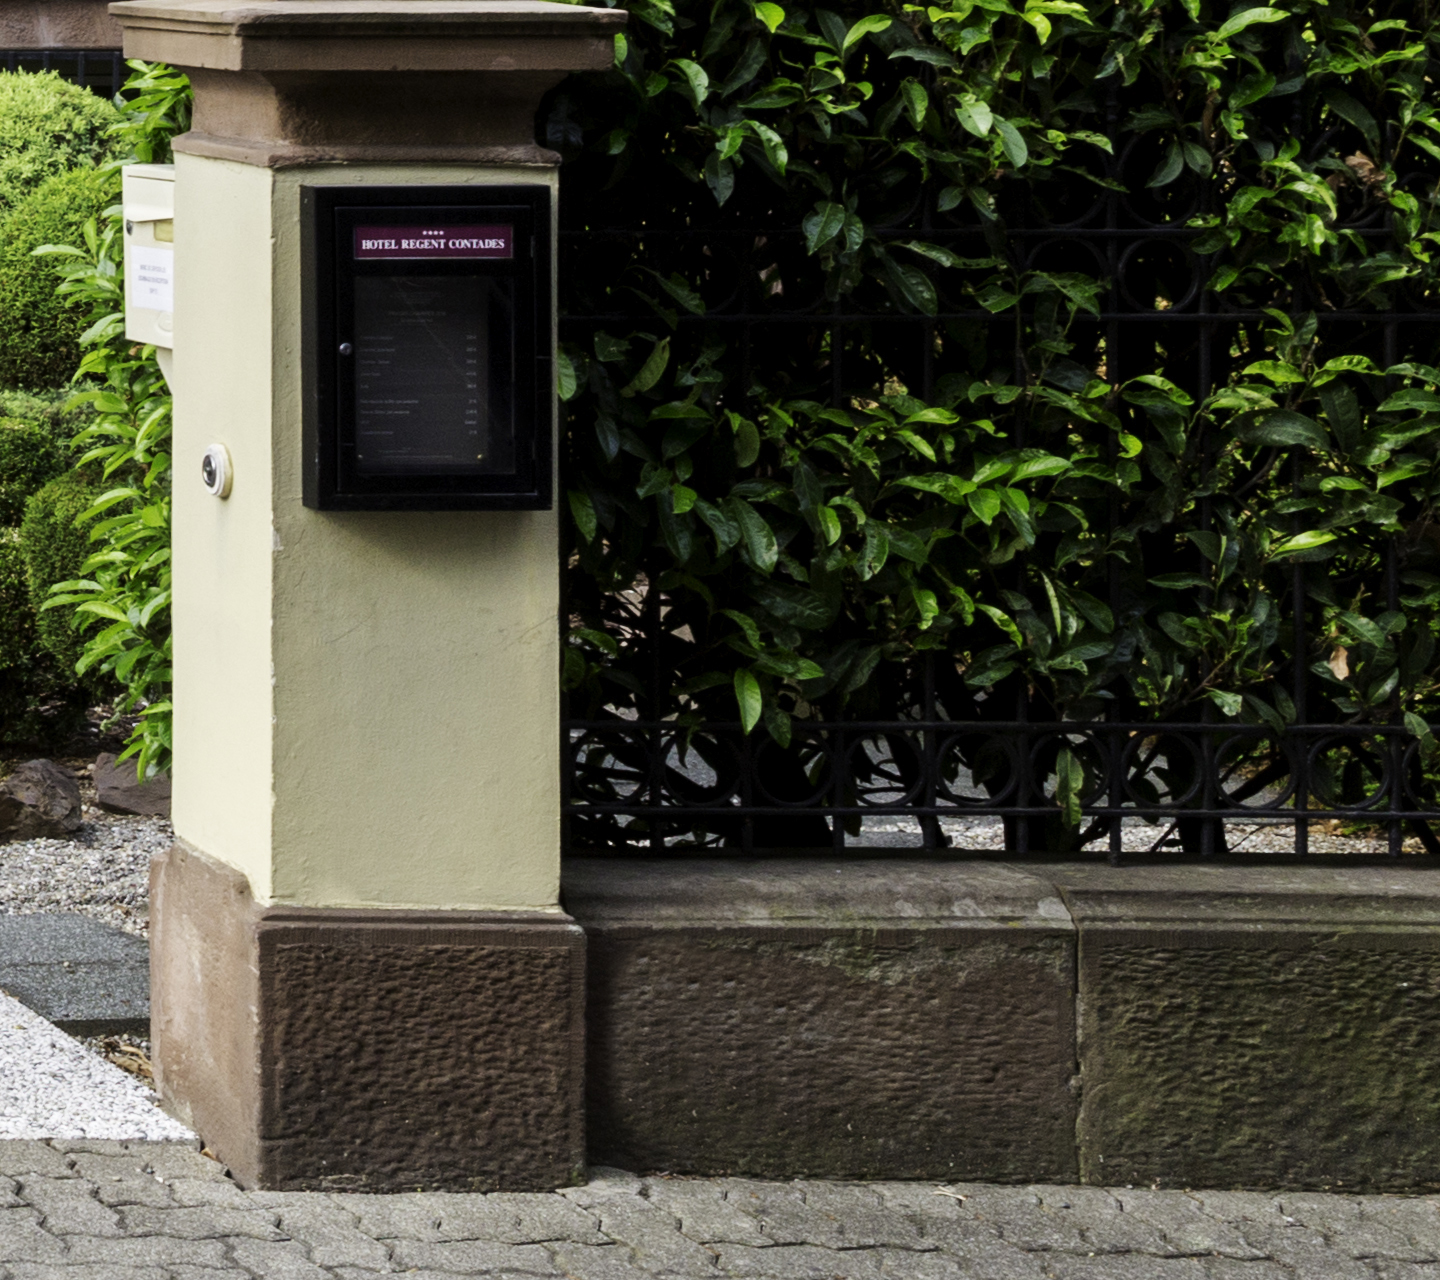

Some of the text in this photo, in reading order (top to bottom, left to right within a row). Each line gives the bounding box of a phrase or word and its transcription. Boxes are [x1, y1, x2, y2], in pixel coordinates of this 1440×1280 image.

[361, 238, 505, 250] HOTEL REGENT CONTADES
